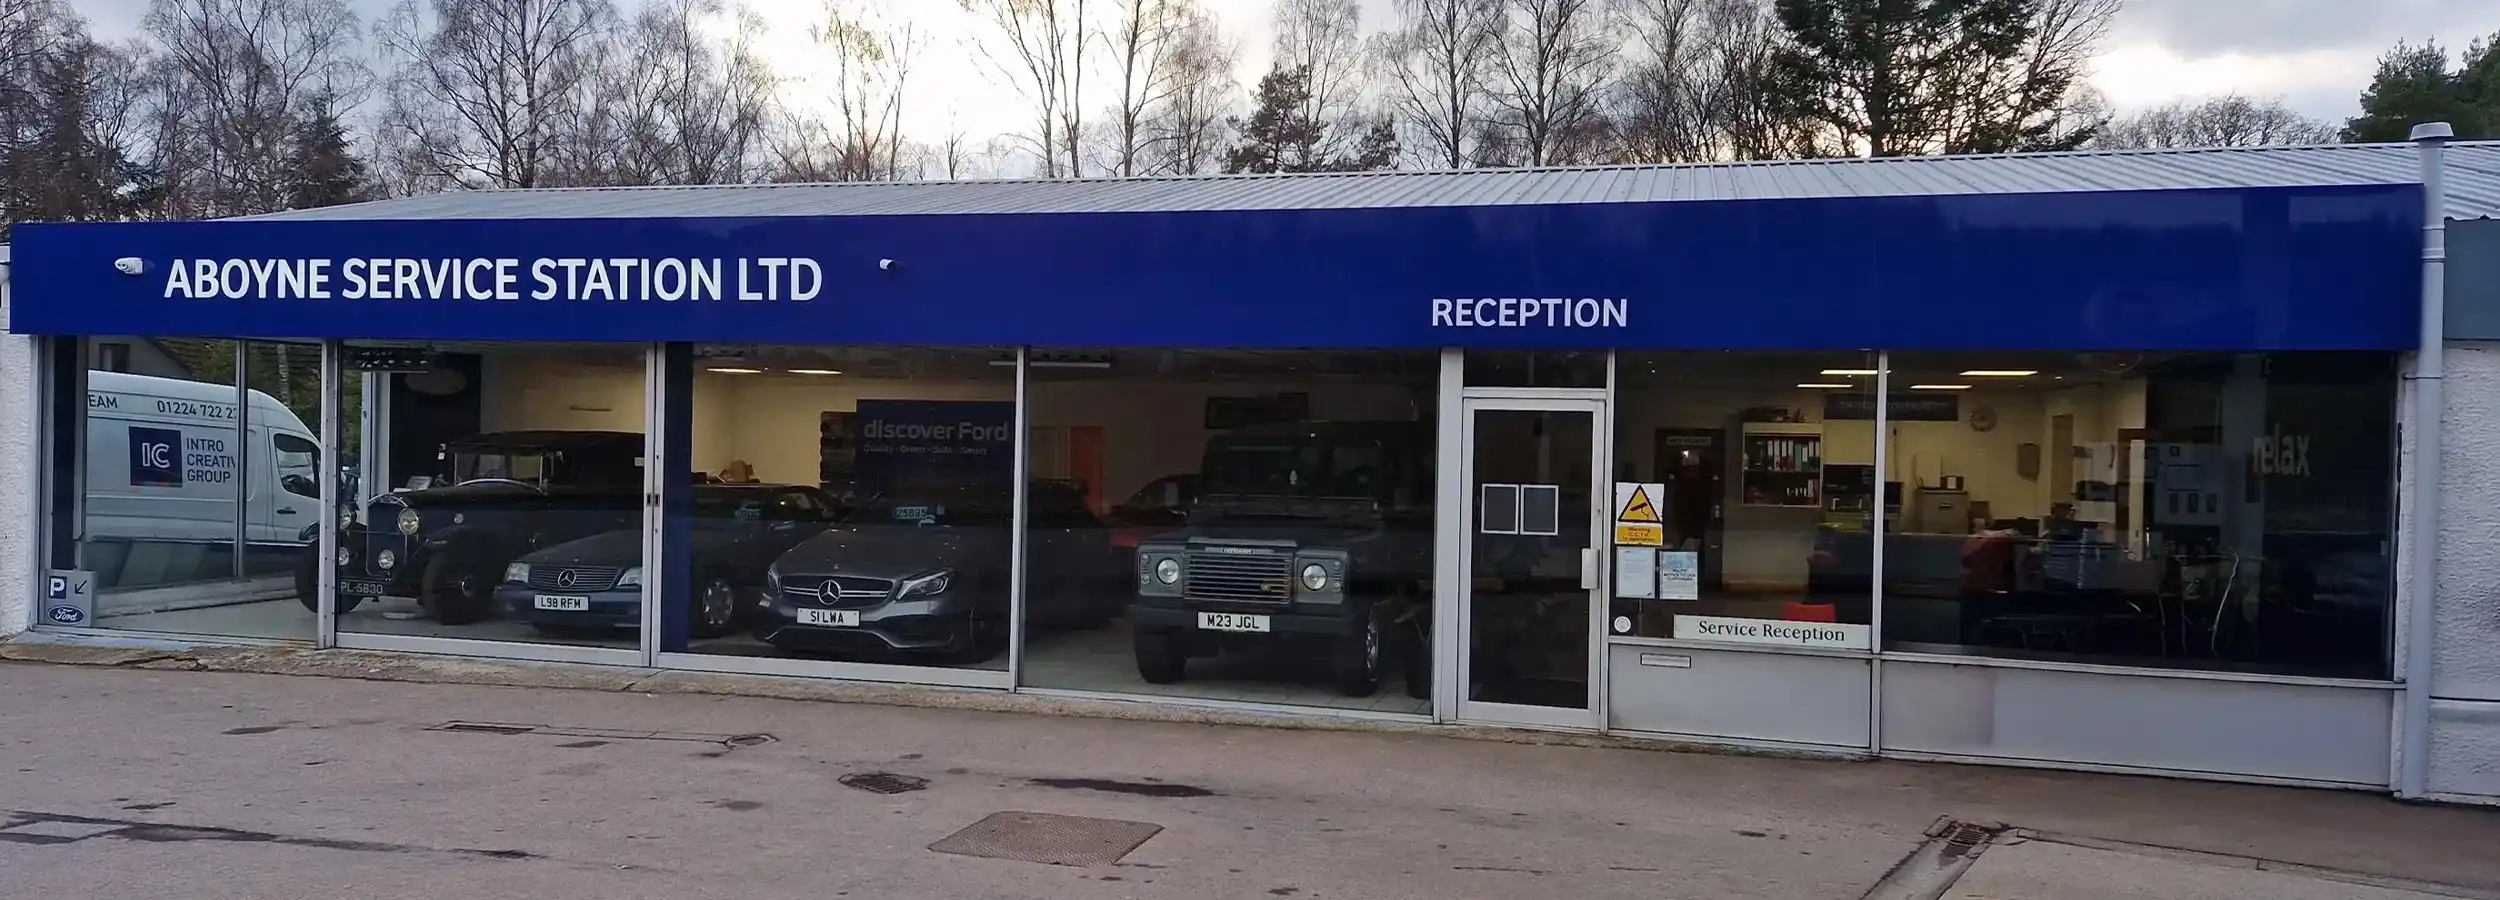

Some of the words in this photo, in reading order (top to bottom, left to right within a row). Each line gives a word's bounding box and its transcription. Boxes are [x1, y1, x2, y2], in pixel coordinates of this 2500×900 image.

[163, 258, 332, 300] ABOYNE
[342, 257, 520, 301] SERVICE
[530, 257, 722, 301] STATION
[738, 257, 823, 301] LTD
[1431, 297, 1628, 328] RECEPTION
[156, 400, 198, 416] 01224
[200, 404, 222, 418] 722
[863, 419, 954, 440] discover
[958, 420, 1009, 441] Ford
[186, 437, 224, 452] INTRO
[2253, 421, 2311, 478] relax
[141, 442, 171, 469] IC
[187, 469, 231, 483] GROUP
[50, 578, 65, 597] P
[541, 596, 558, 608] L98
[55, 608, 78, 621] Ford
[1207, 614, 1232, 628] M23
[1236, 616, 1260, 629] JGL
[1698, 620, 1757, 637] Service
[1762, 624, 1845, 643] Reception
